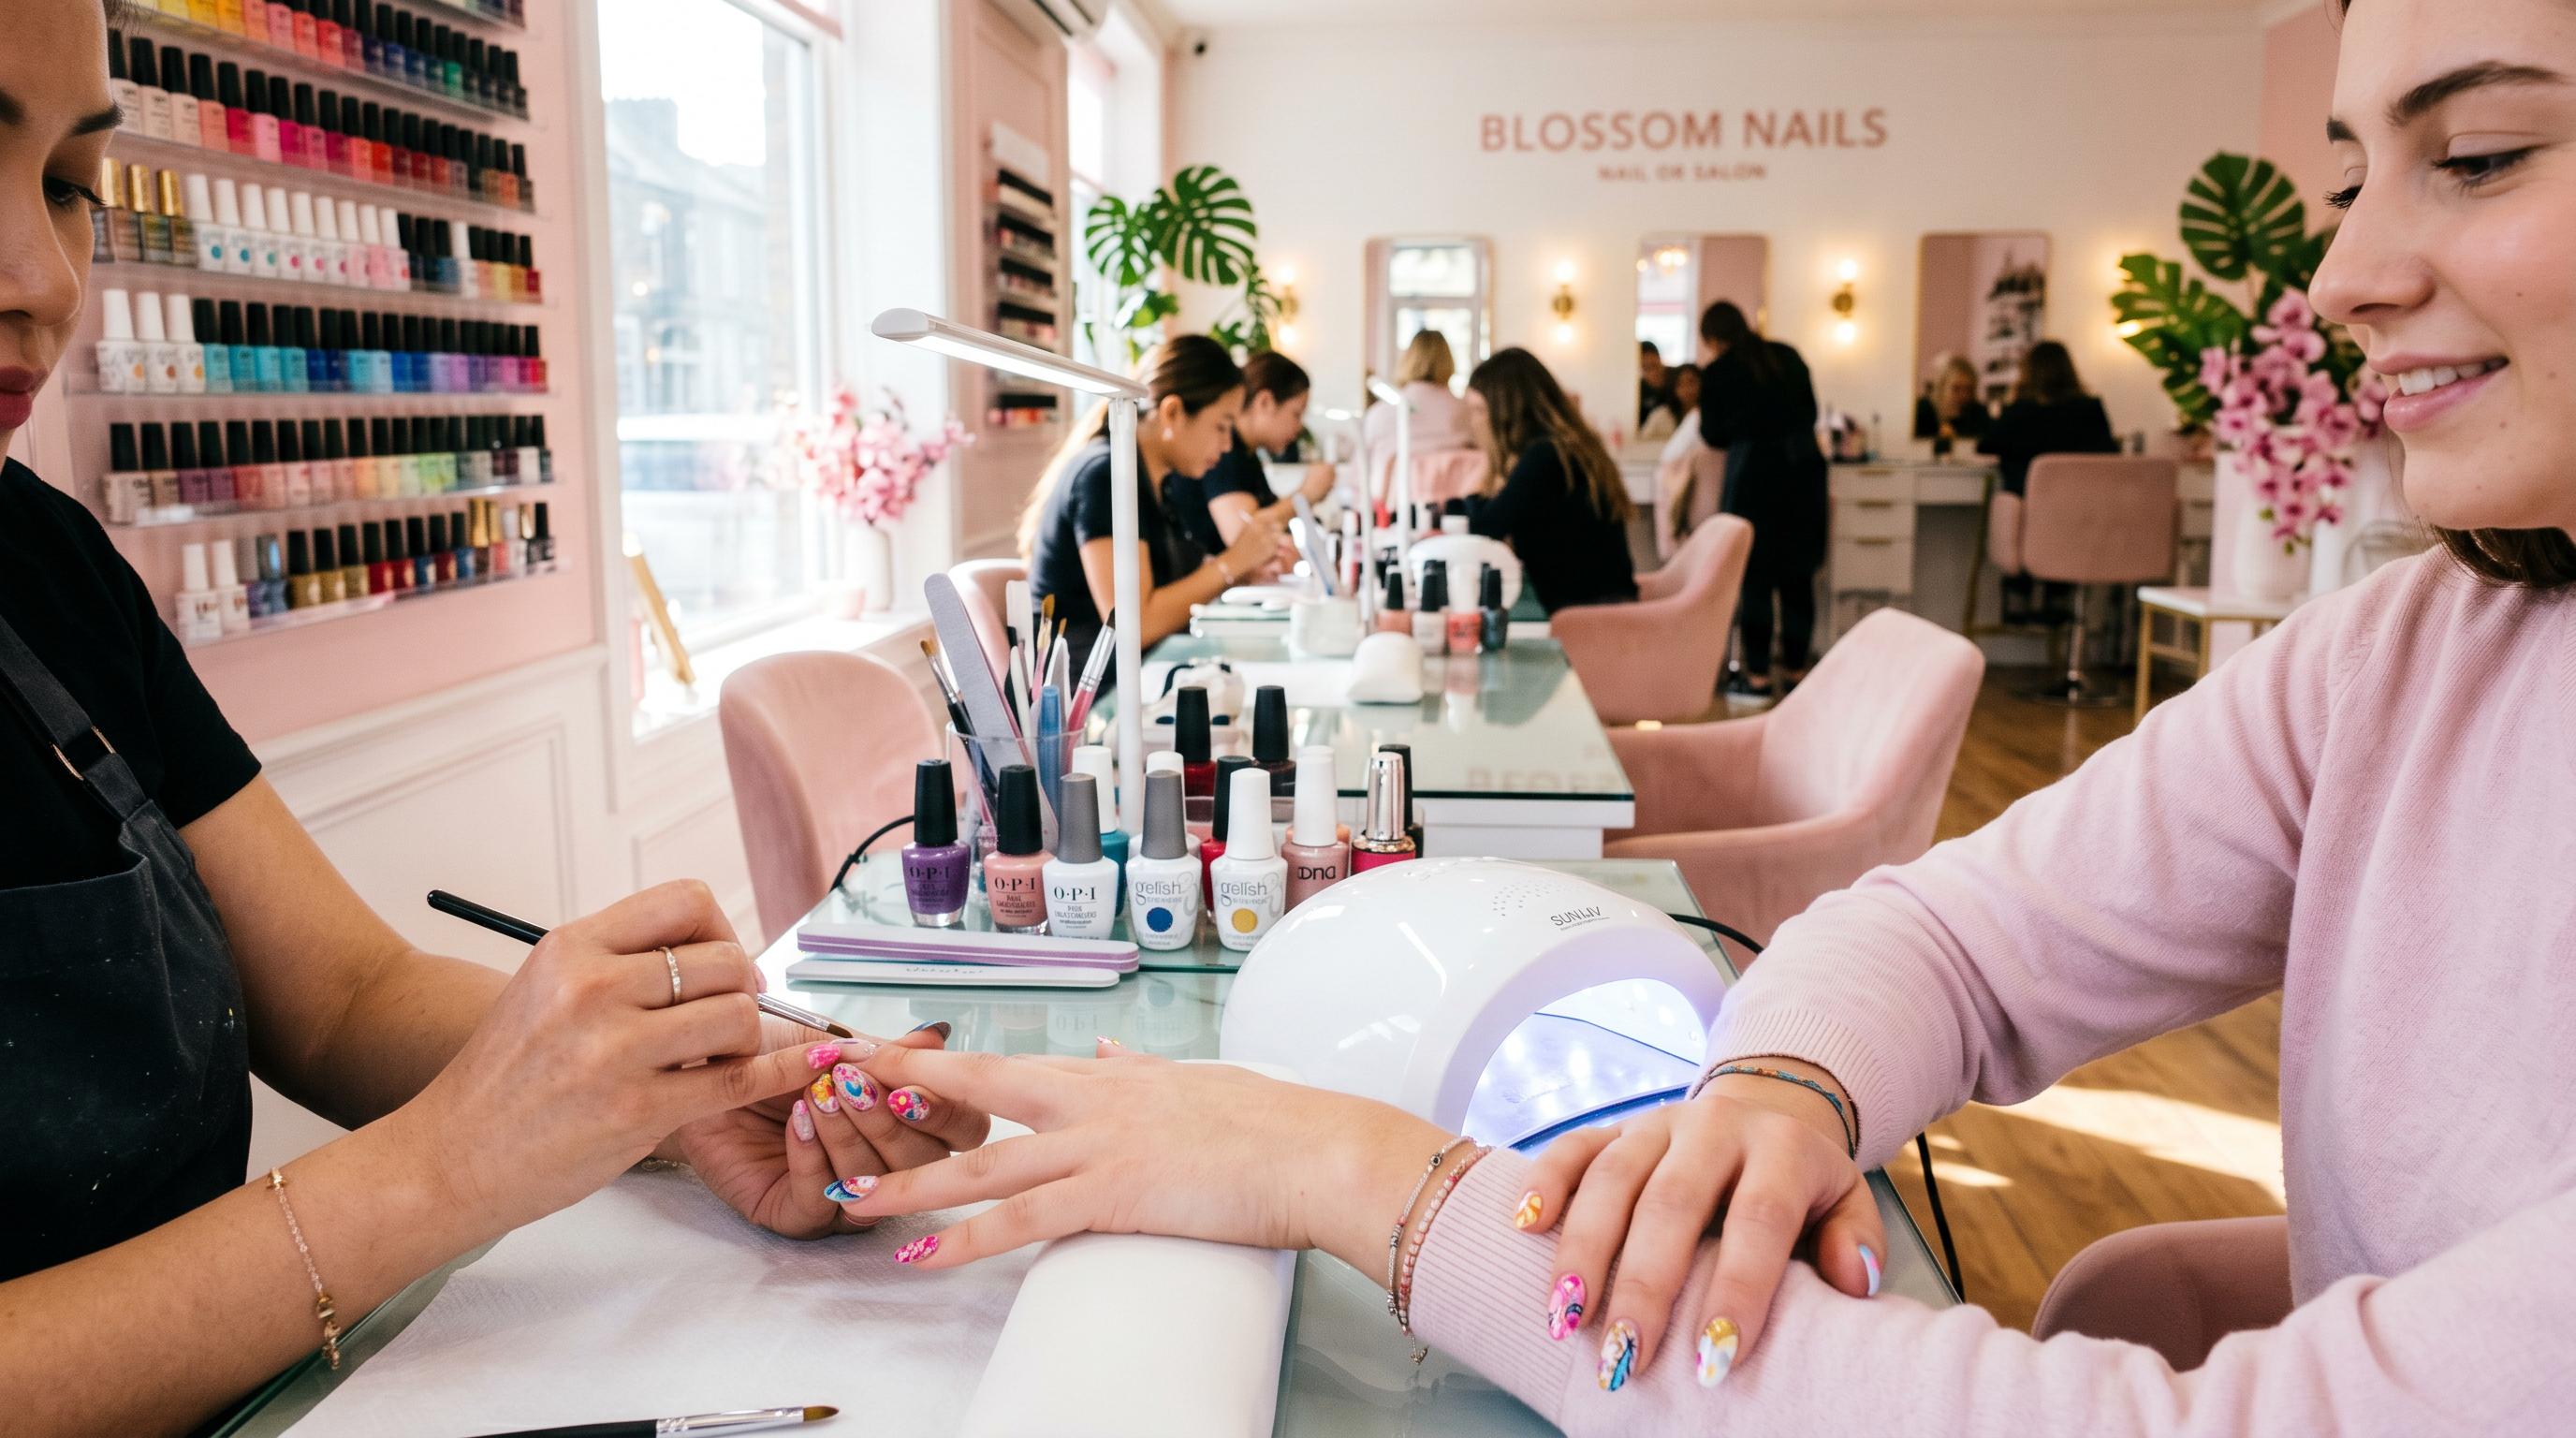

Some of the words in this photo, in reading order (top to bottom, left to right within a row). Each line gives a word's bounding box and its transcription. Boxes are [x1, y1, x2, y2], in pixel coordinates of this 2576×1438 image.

[1481, 110, 1721, 152] BLOSSOM
[1743, 109, 1888, 149] NAILS
[1135, 880, 1181, 905] gelish
[1221, 881, 1267, 906] gelish
